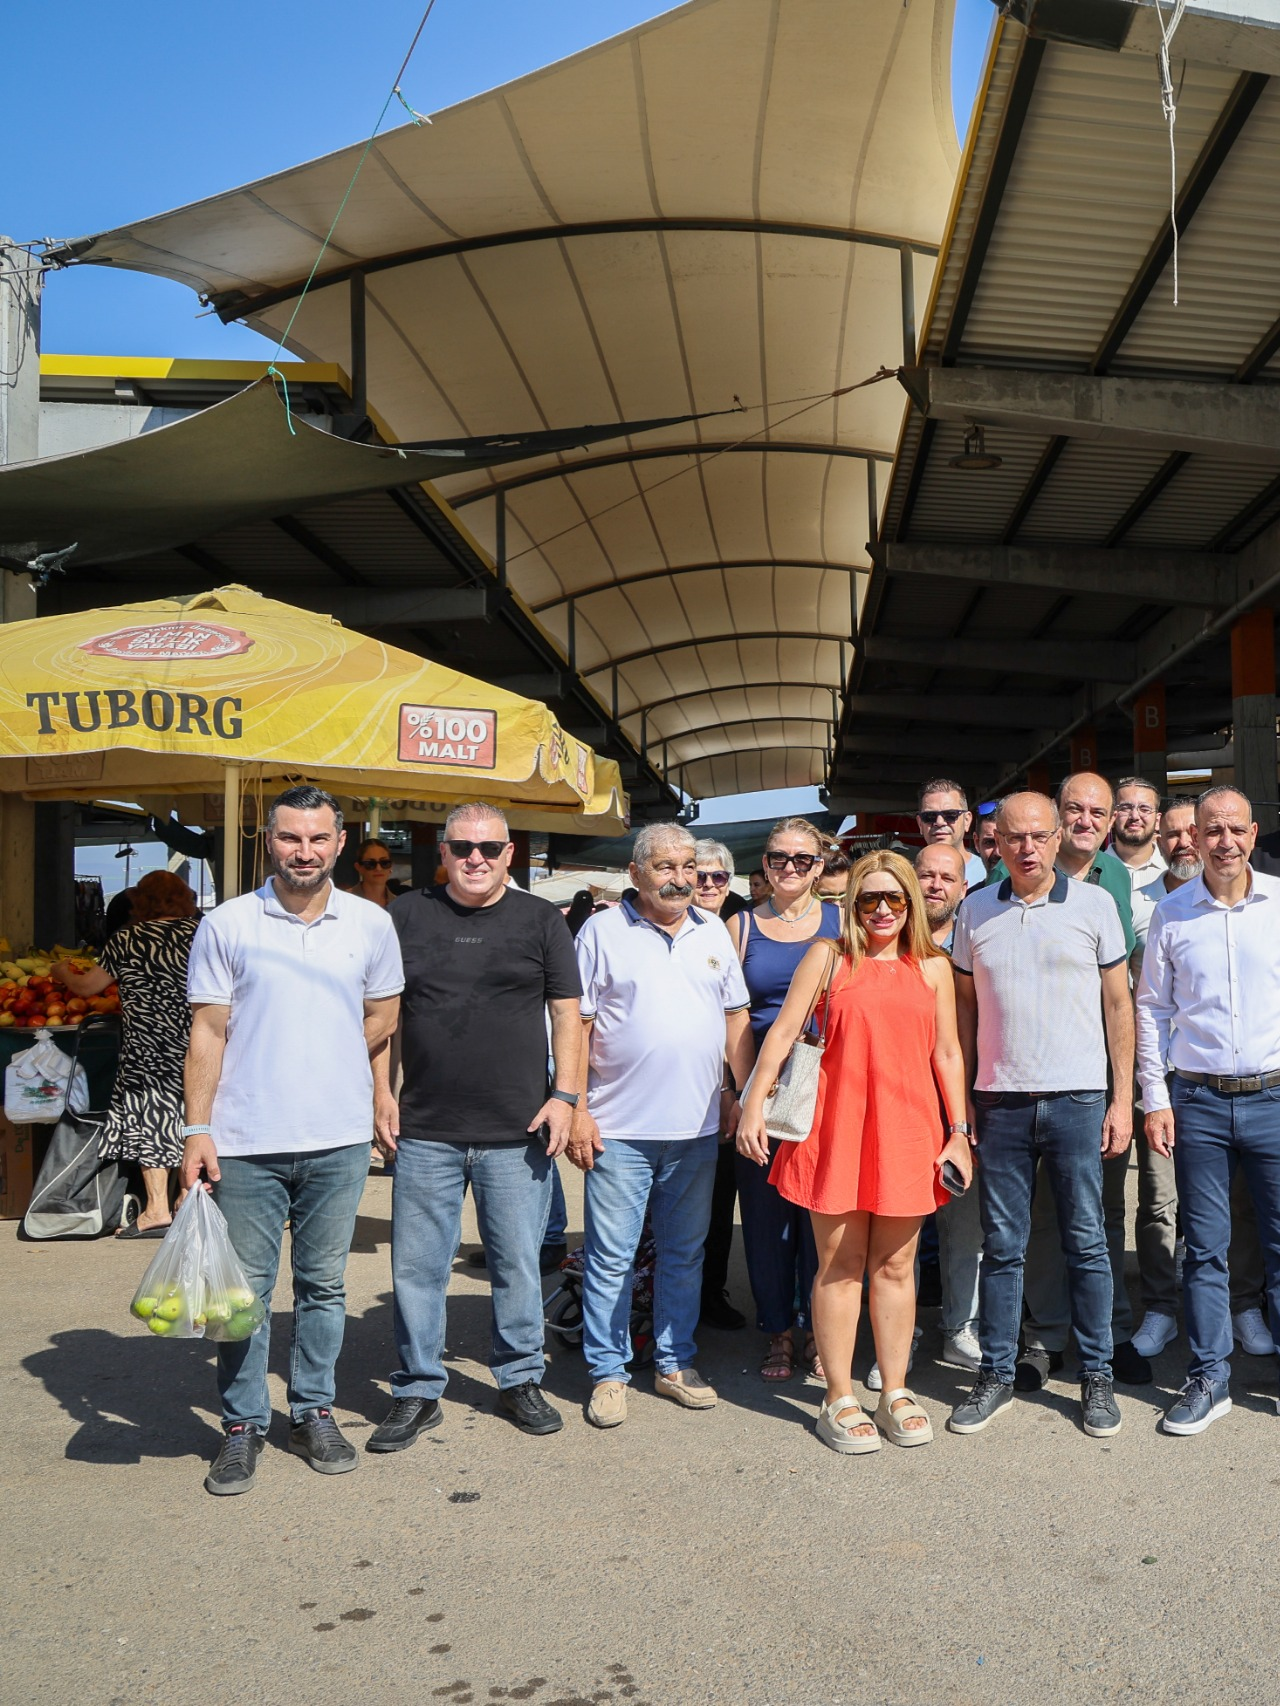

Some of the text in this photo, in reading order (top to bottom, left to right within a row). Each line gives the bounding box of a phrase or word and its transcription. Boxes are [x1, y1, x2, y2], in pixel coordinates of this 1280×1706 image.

[131, 637, 204, 646] SAFLIK
[139, 631, 212, 641] ALMAN
[127, 643, 199, 651] YASASI
[25, 689, 243, 740] TUBORG
[1145, 705, 1160, 728] B
[407, 711, 488, 744] %100
[418, 741, 479, 761] MALT
[454, 936, 484, 944] GUESS
